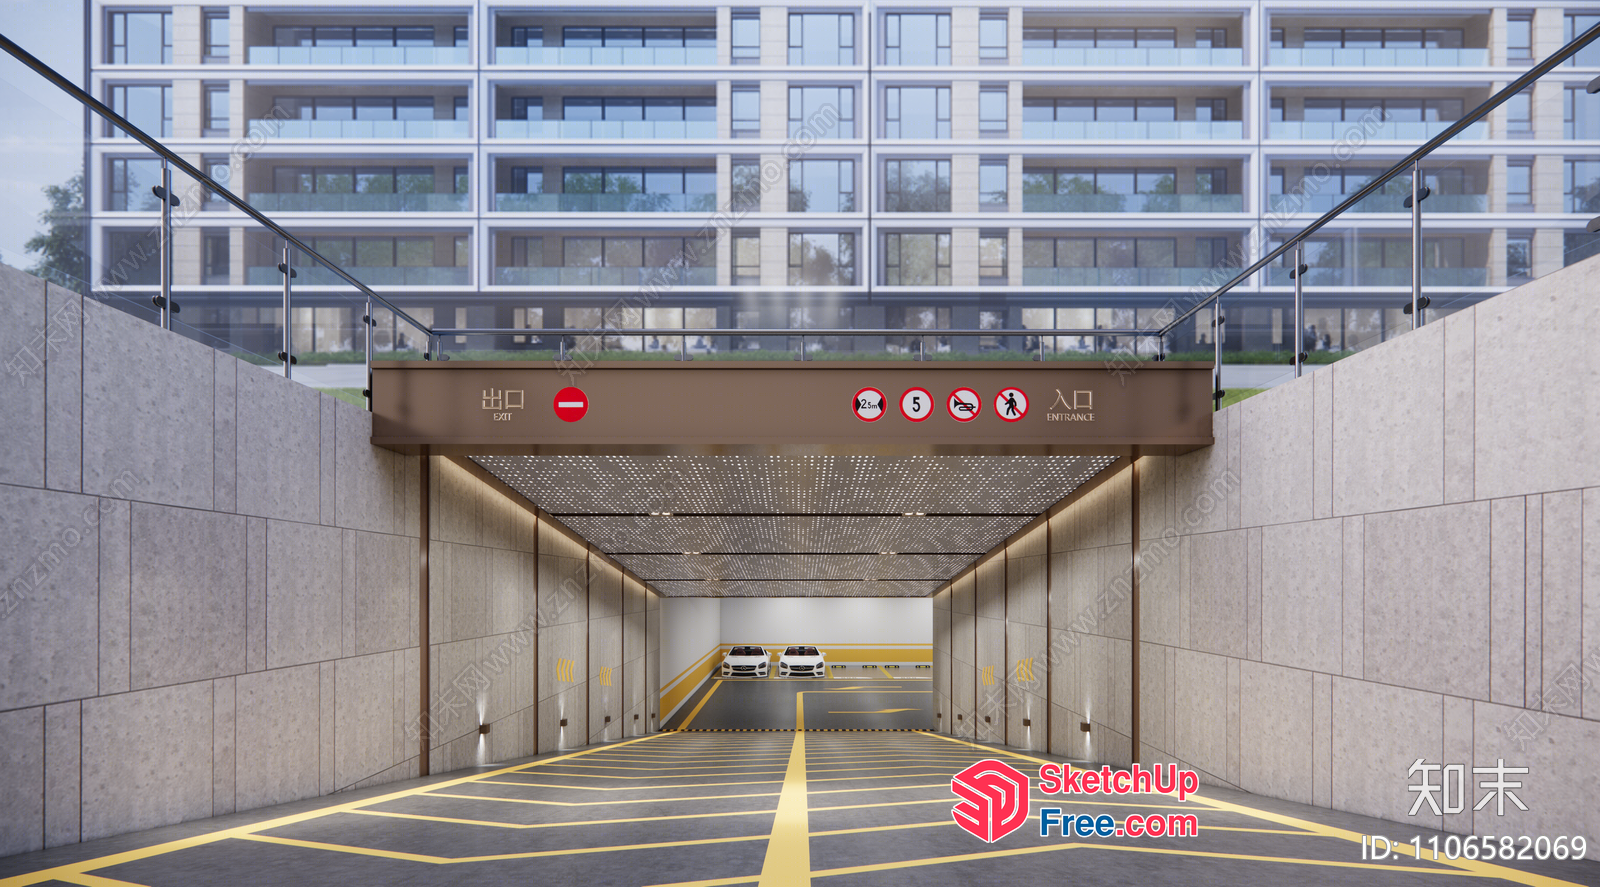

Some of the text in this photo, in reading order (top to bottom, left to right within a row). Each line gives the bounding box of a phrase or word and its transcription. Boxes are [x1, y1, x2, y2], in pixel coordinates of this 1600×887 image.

[482, 387, 524, 410] 出口
[912, 396, 921, 413] 5
[1049, 388, 1093, 410] 入口
[493, 412, 512, 421] EXIT
[1046, 412, 1095, 421] ENTRANCE
